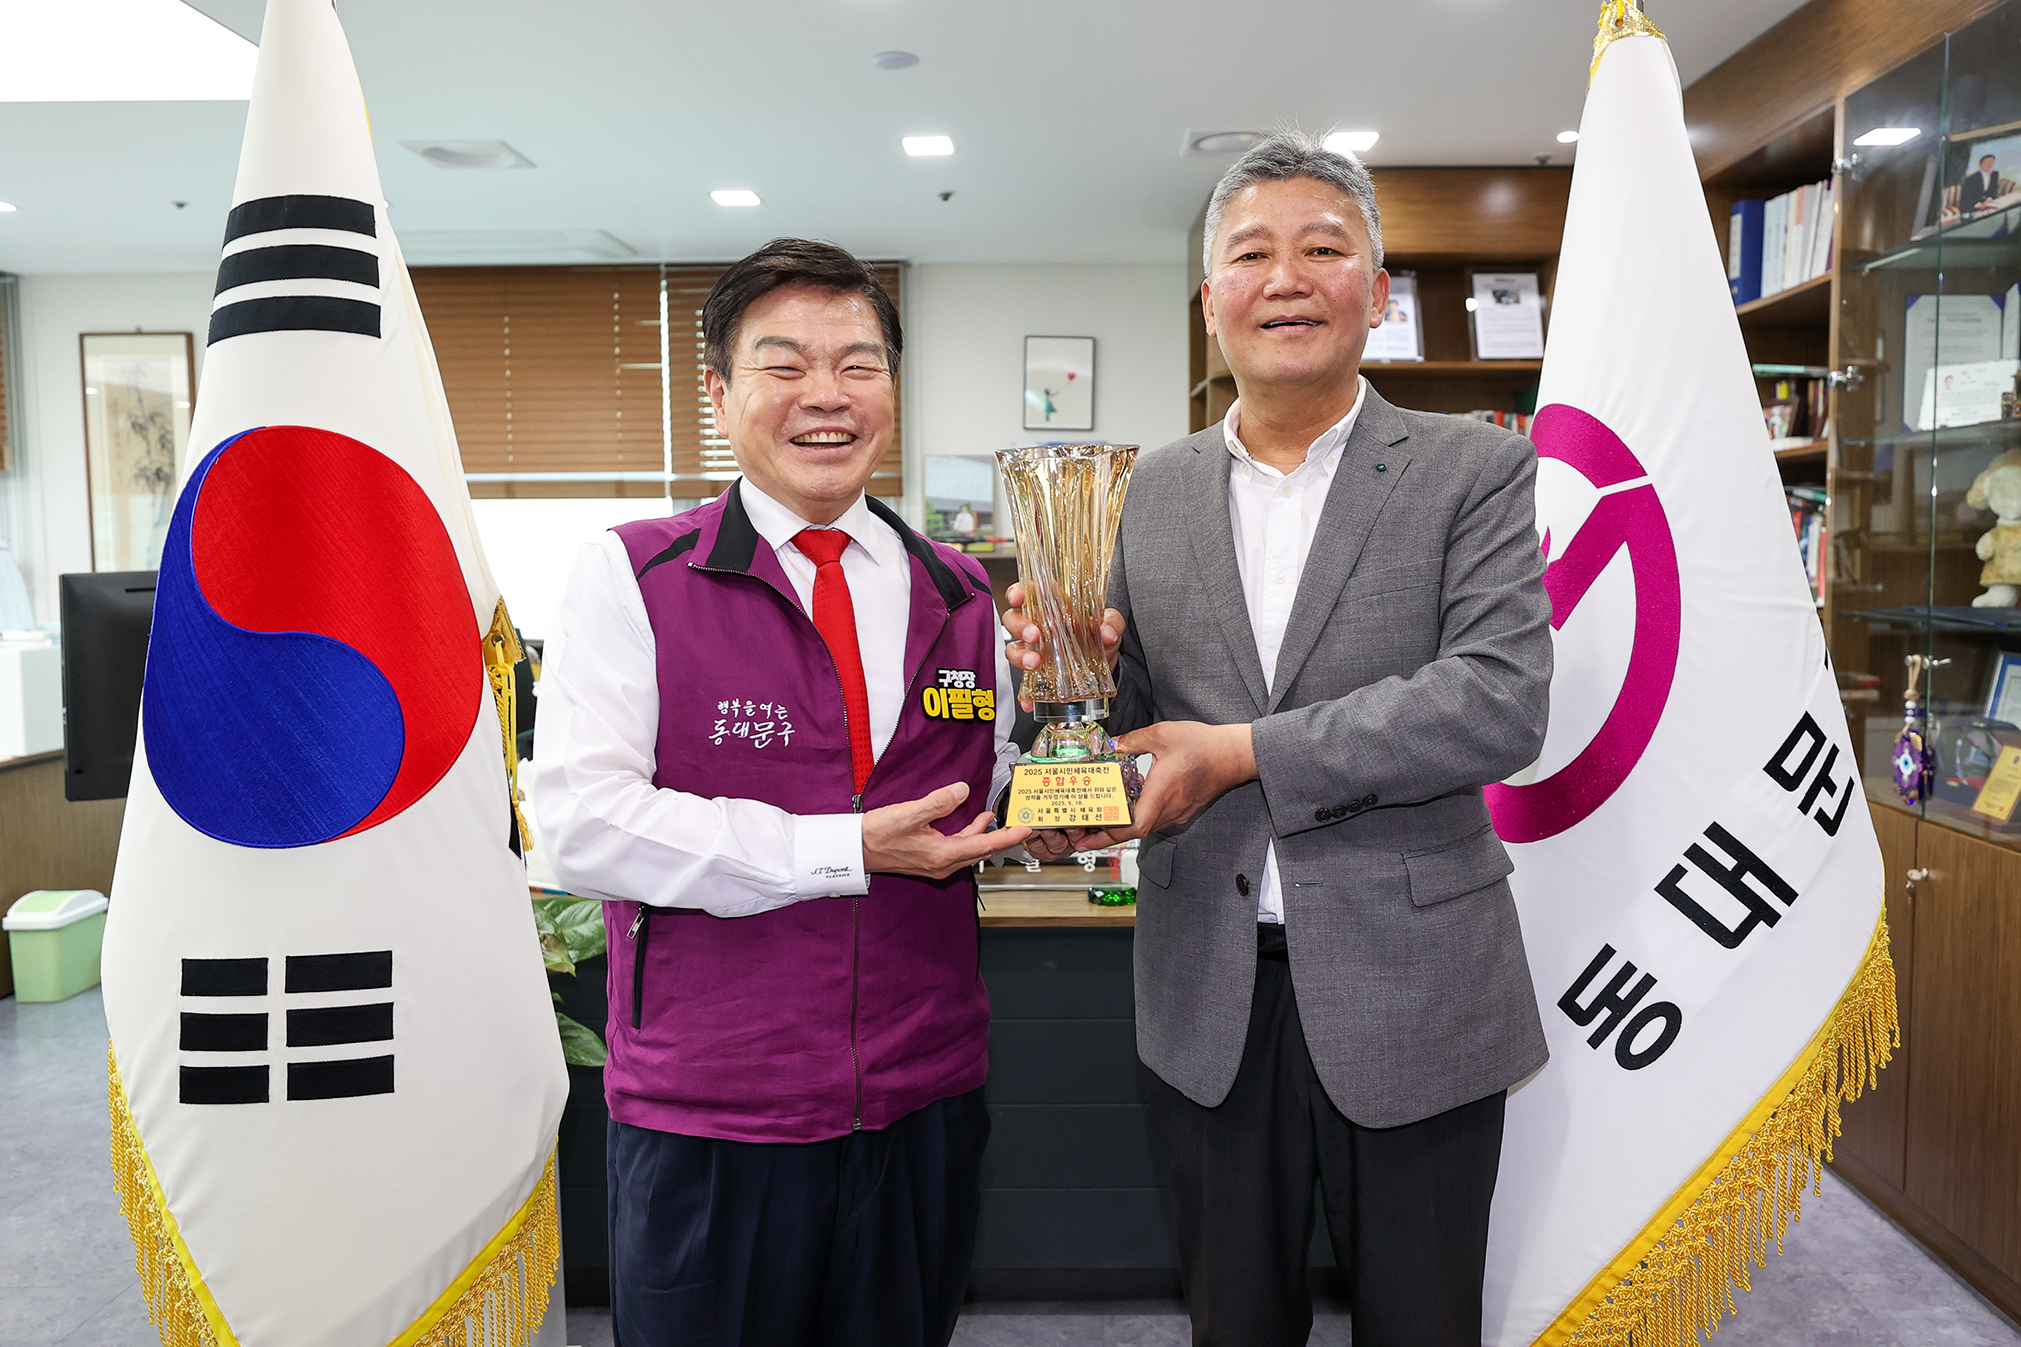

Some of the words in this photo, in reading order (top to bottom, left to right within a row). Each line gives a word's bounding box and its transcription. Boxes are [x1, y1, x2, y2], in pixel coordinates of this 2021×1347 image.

[938, 669, 976, 688] 구청장
[717, 698, 757, 717] 행복을
[759, 701, 789, 720] 여는
[922, 686, 996, 721] 이필형
[708, 719, 796, 749] 동대문구
[1024, 768, 1043, 776] 2025
[1044, 766, 1110, 776] 서울시민체육대축전
[1557, 648, 1855, 1070] 동대문
